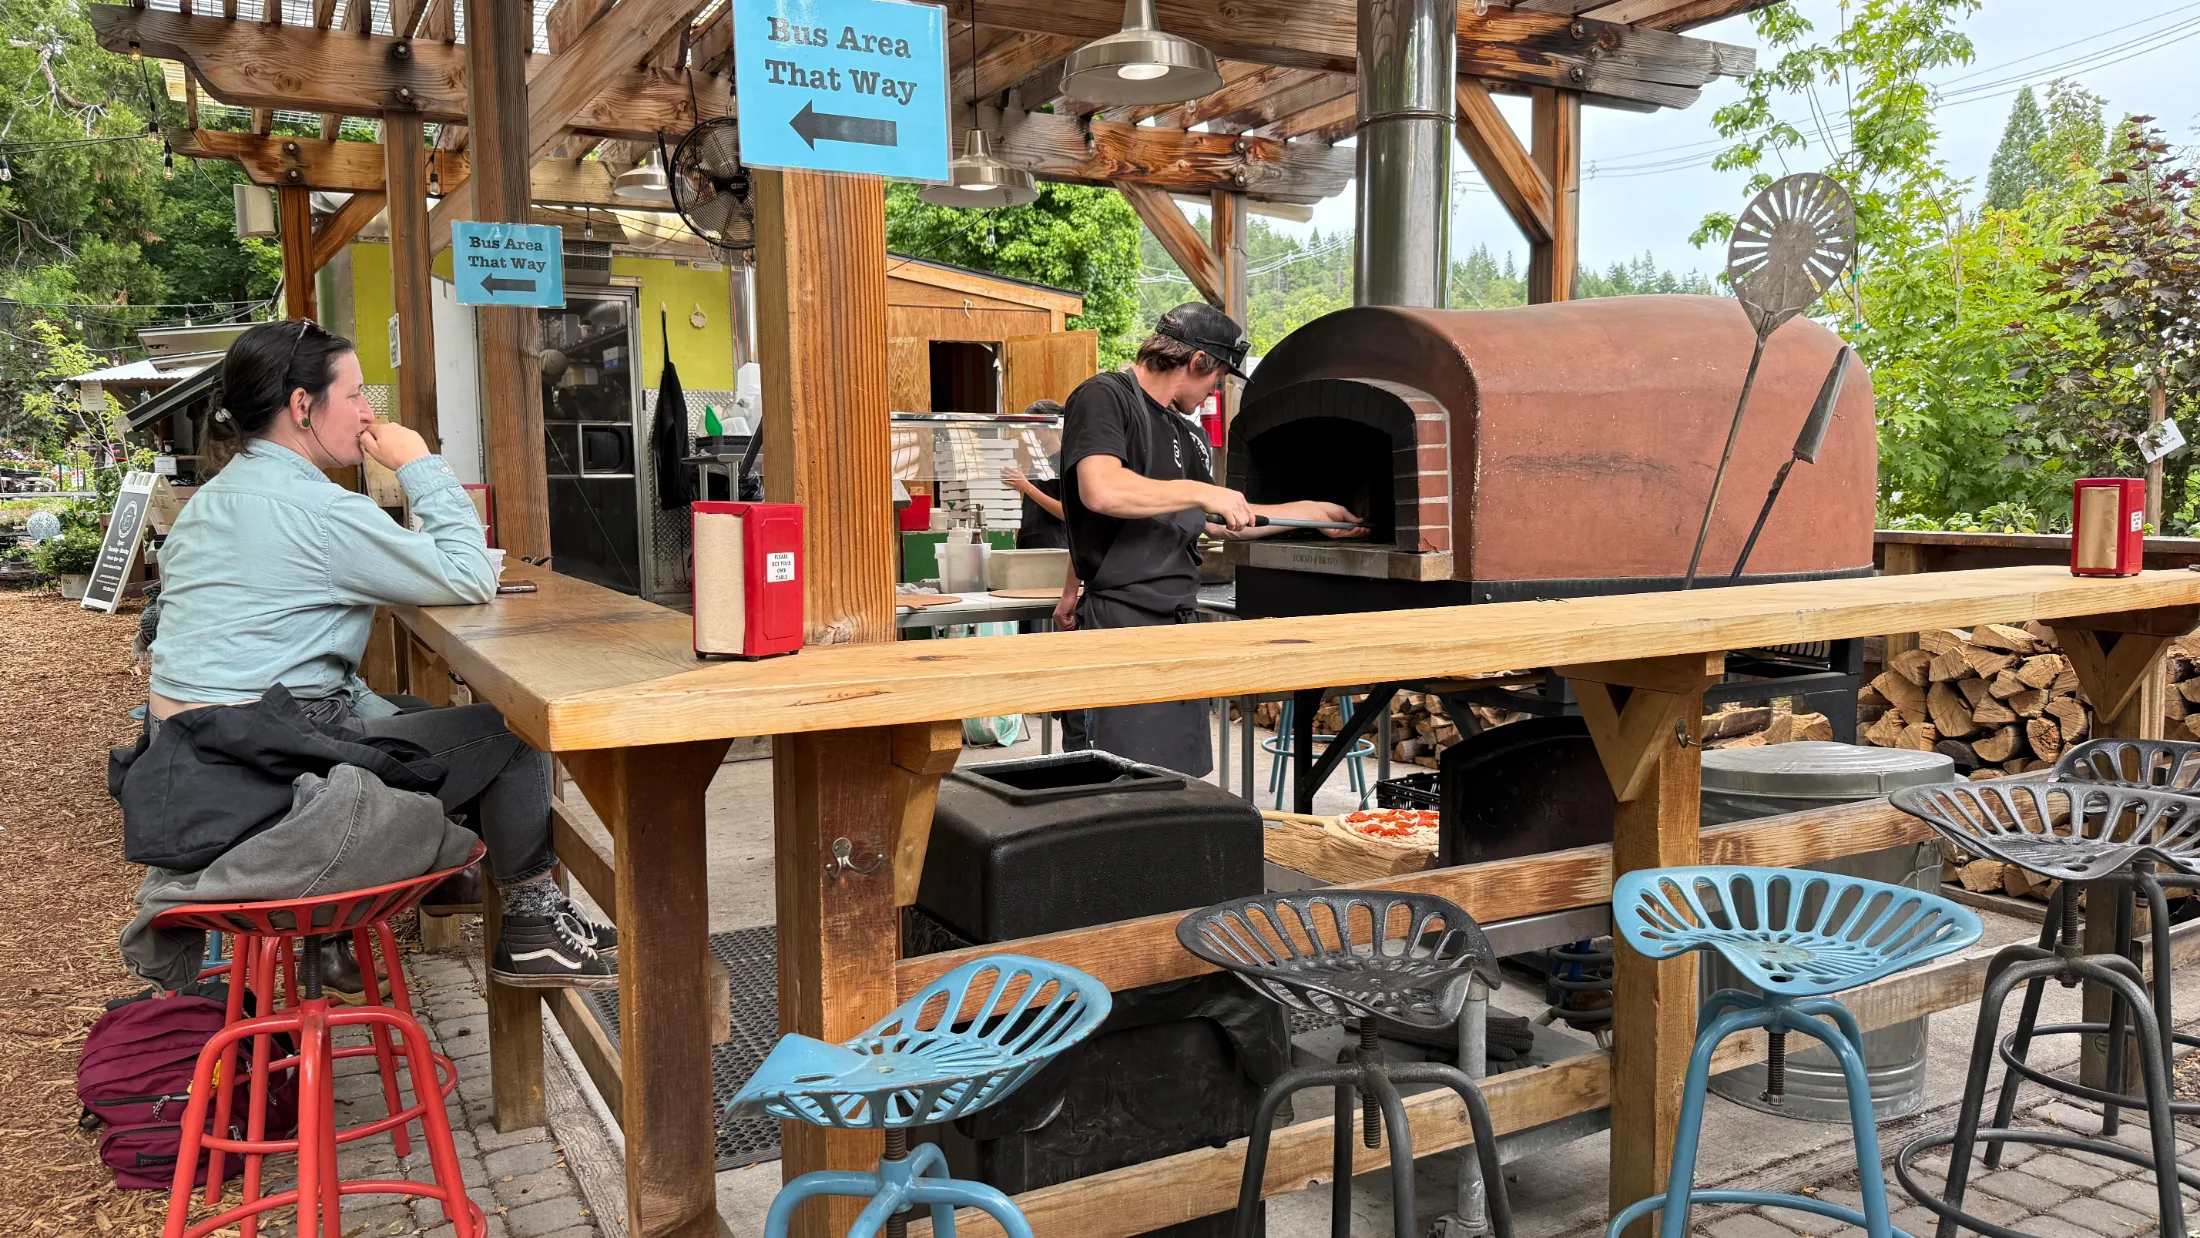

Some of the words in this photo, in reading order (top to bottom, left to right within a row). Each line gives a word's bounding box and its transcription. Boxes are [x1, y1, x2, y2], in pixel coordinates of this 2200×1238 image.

[767, 16, 828, 47] Bus
[836, 26, 912, 58] Area
[765, 58, 841, 91] That
[848, 68, 917, 105] Way
[468, 236, 500, 249] Bus
[504, 238, 543, 251] Area
[468, 256, 507, 268] That
[510, 257, 546, 273] Way
